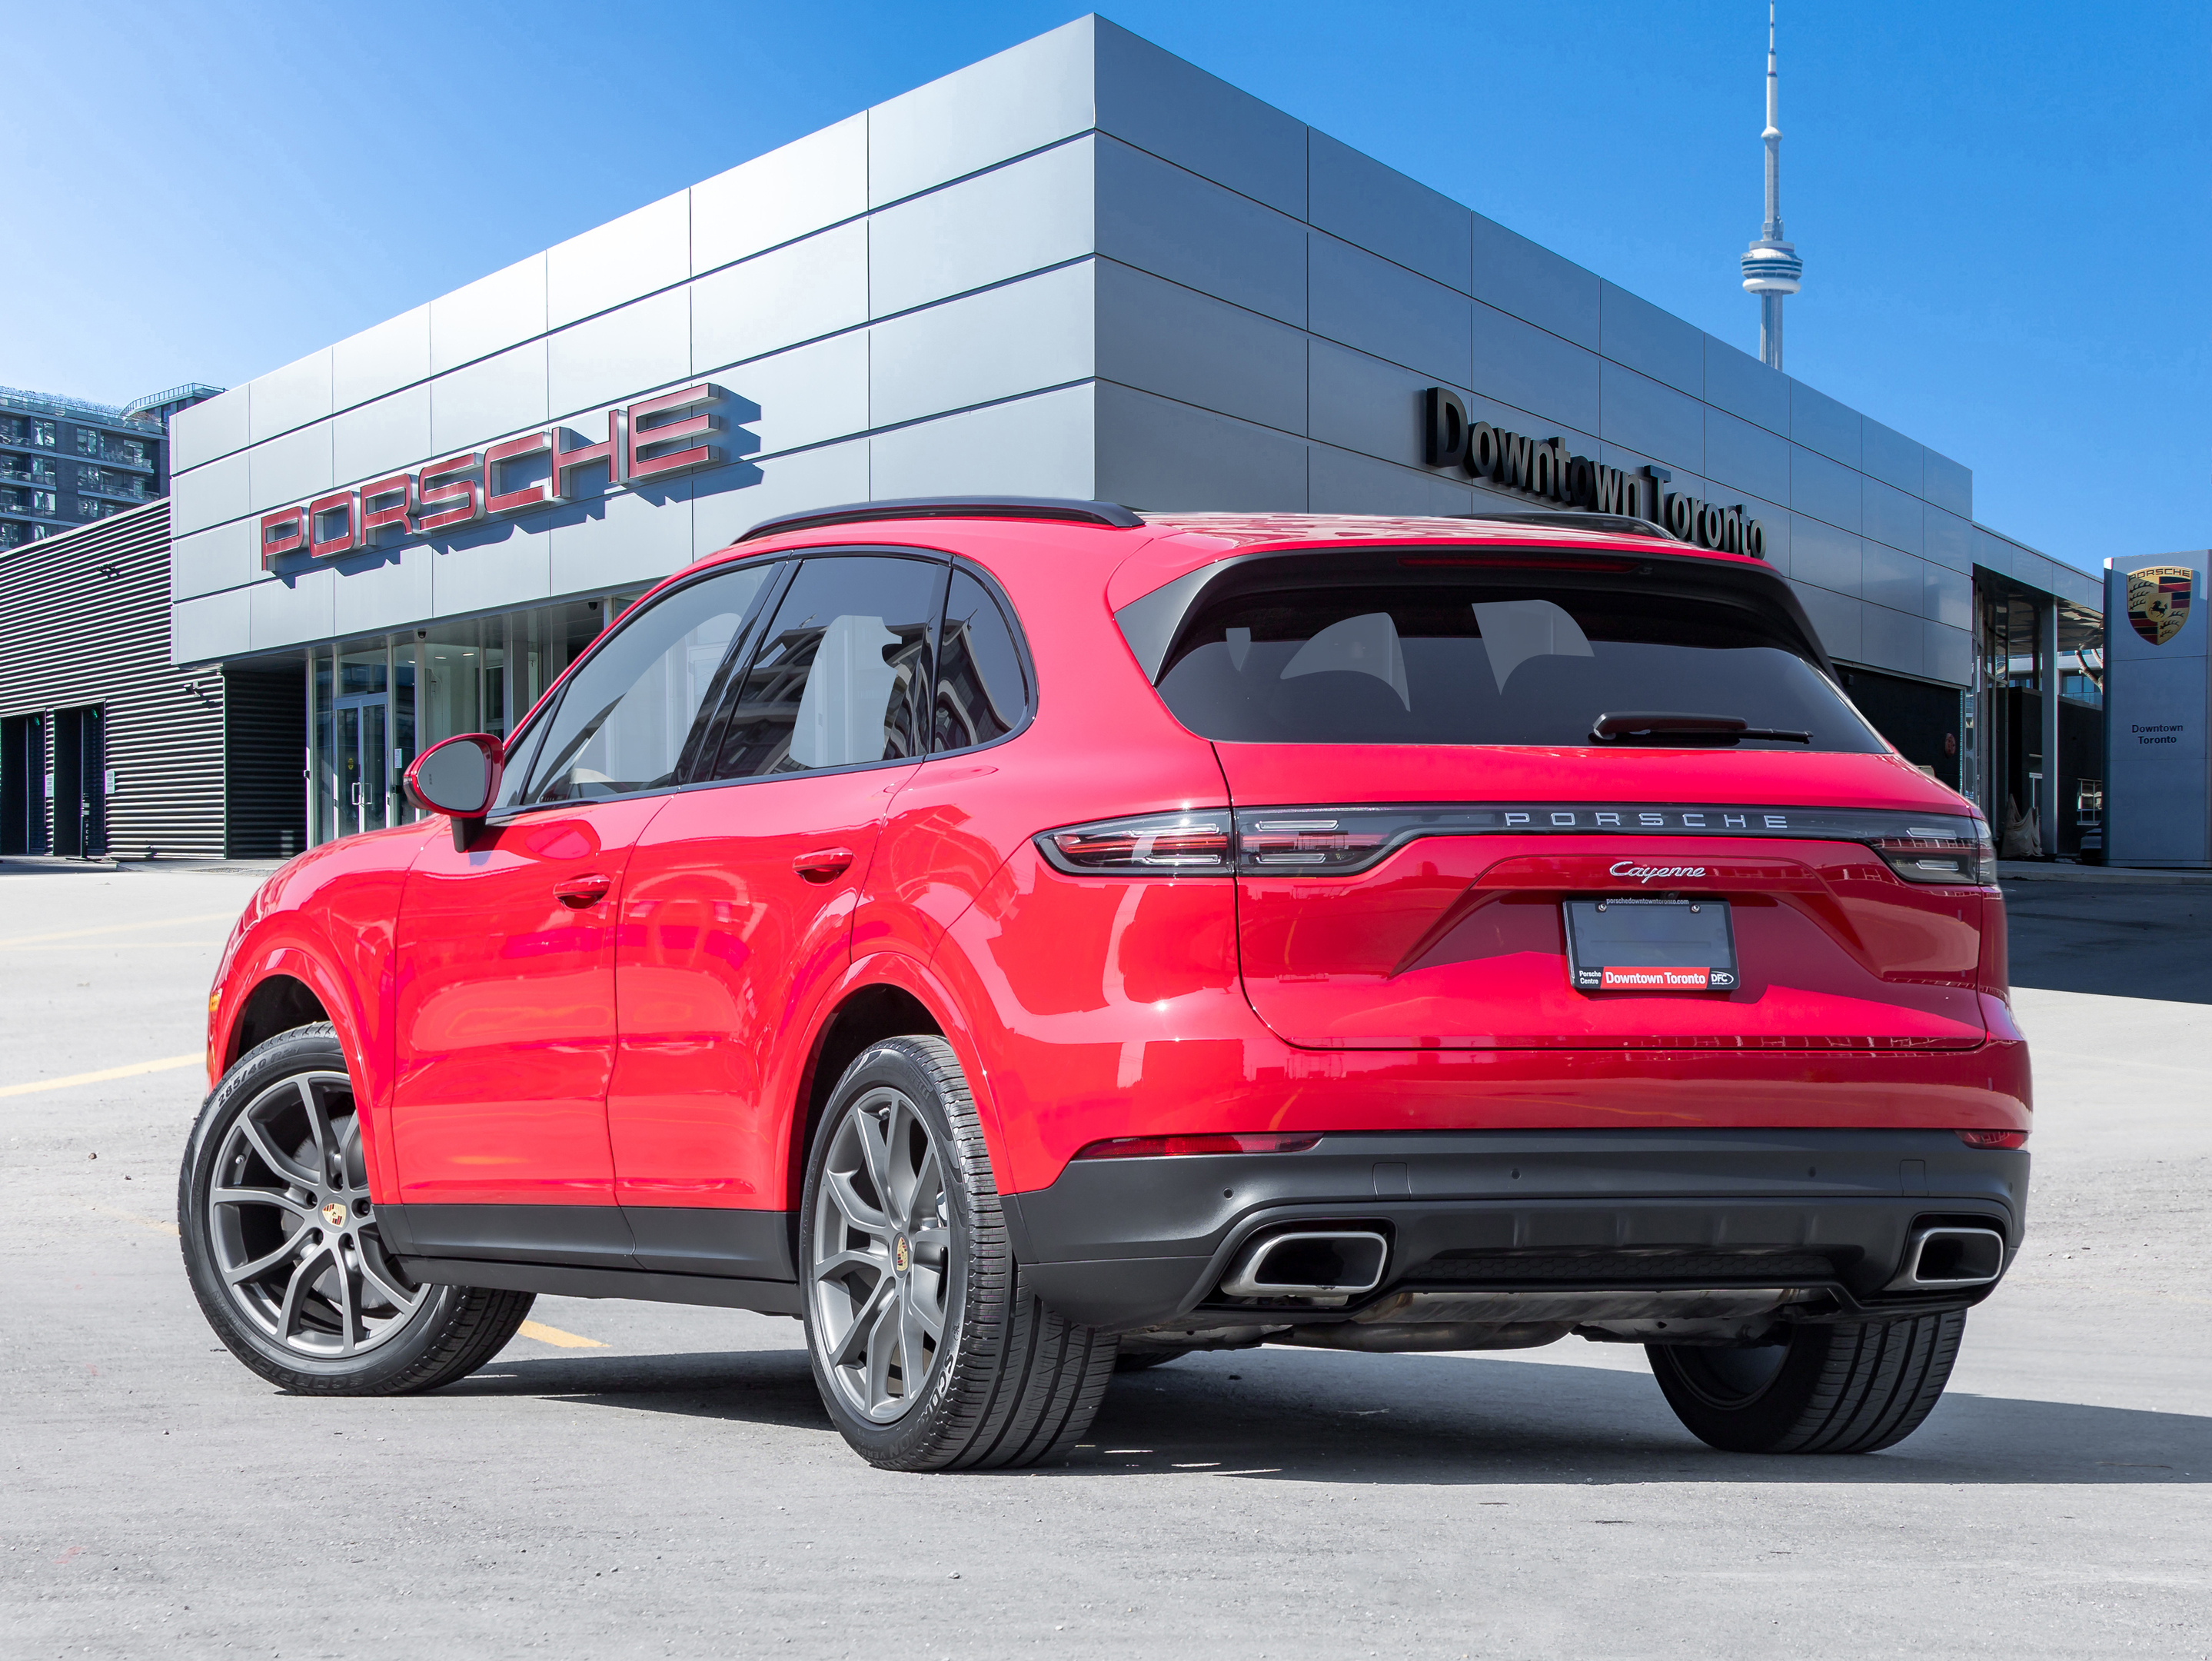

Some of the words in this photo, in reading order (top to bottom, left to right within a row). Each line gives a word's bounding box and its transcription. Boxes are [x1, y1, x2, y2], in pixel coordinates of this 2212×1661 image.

[261, 383, 720, 571] PORSCHE
[1426, 387, 1641, 519] Downtown
[1644, 464, 1767, 561] Toronto
[2128, 568, 2190, 582] PORSCHE
[2131, 724, 2183, 734] Downtown
[2137, 735, 2177, 744] Toronto
[1505, 812, 1788, 828] PORSCHE
[1609, 861, 1706, 884] Cayenne
[1605, 971, 1663, 984] Downtown
[1664, 972, 1706, 985] Toronto
[1711, 974, 1728, 982] DFC
[218, 1057, 267, 1107] 285/40
